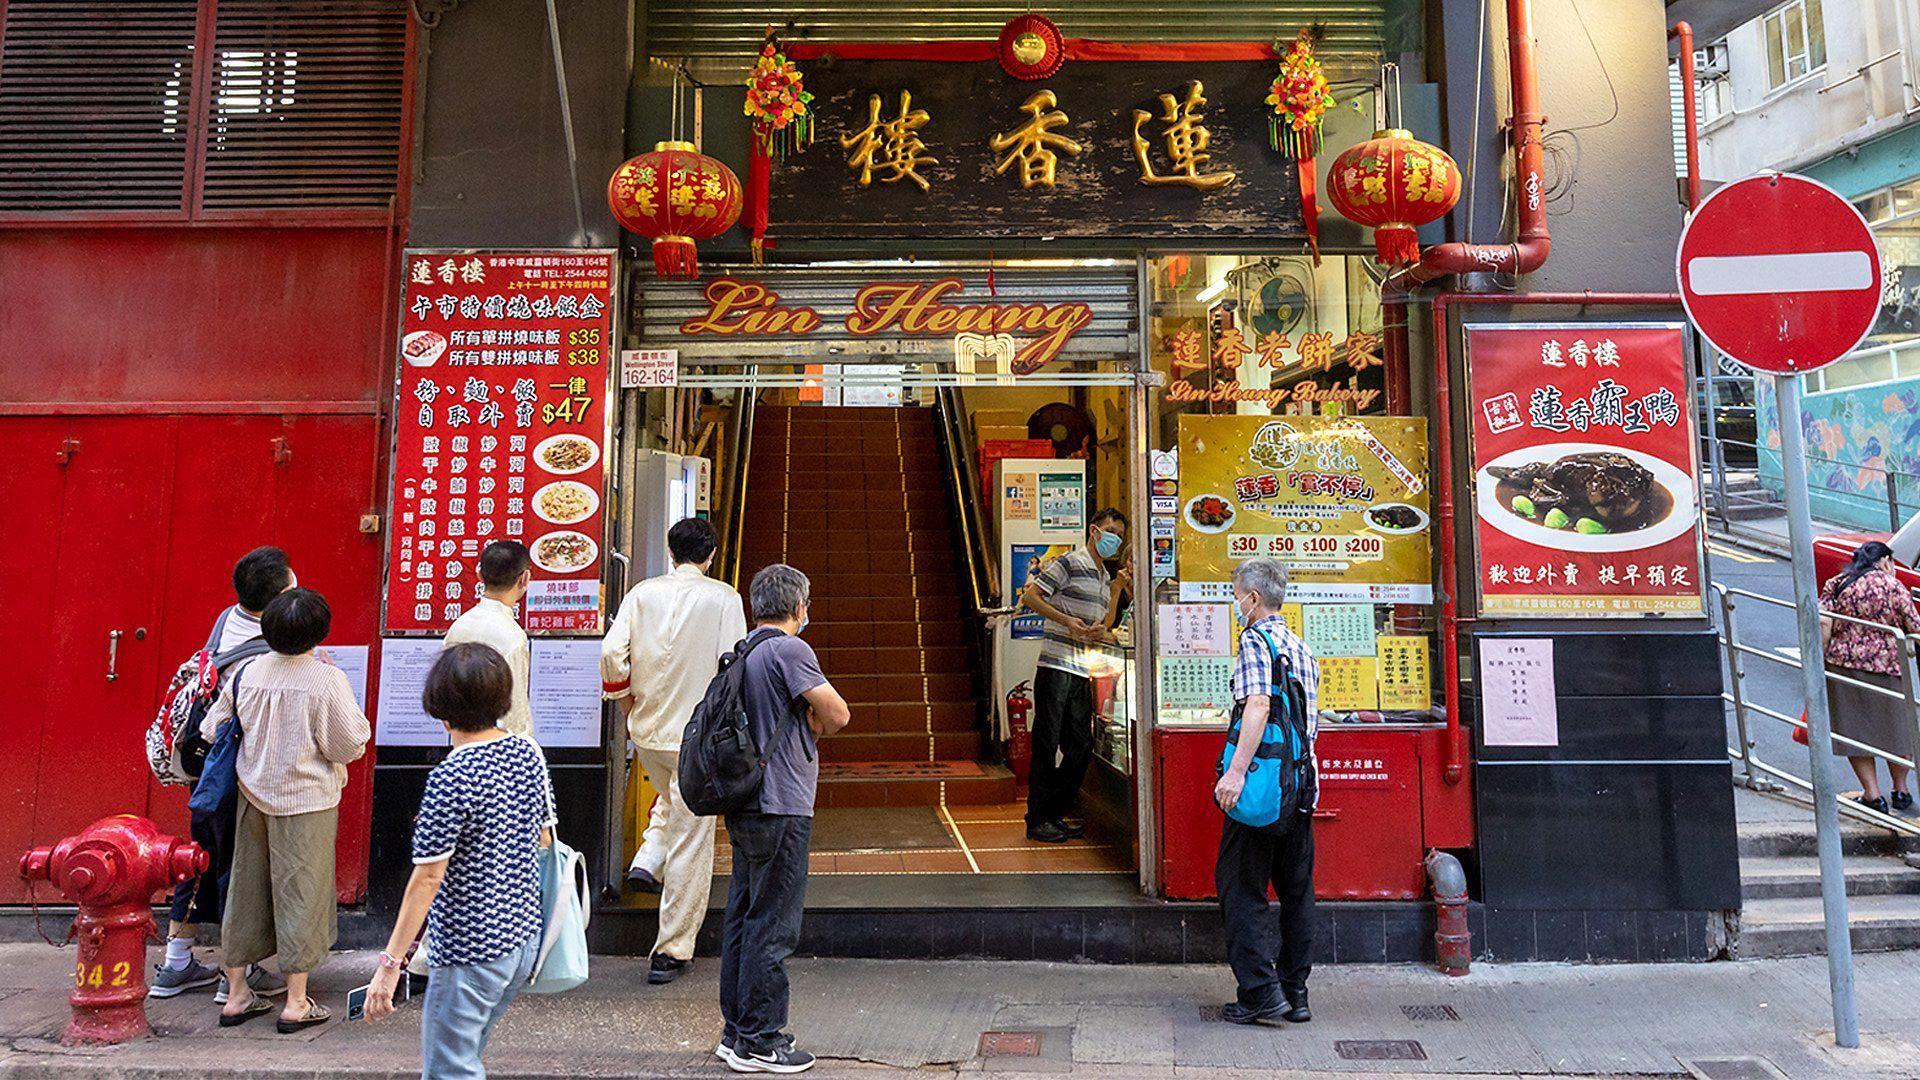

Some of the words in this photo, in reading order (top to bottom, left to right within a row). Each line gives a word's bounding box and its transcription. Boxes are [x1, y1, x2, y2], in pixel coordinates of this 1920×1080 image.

[411, 258, 486, 285] 蓮香樓
[523, 270, 541, 279] 電話
[544, 270, 563, 278] TEL:
[564, 269, 586, 278] 2544
[449, 330, 561, 346] 所有單拼燒味飯
[568, 329, 601, 345] $35
[681, 277, 821, 335] Lin
[846, 278, 1094, 375] Heung
[448, 350, 560, 366] 所有雙拼燒味飯
[567, 350, 600, 366] $38
[1171, 328, 1385, 373] 蓮香老餅家
[1540, 338, 1621, 368] 蓮香樓
[549, 377, 587, 395] 一律
[624, 369, 674, 384] 162-164
[1165, 379, 1210, 402] Lin
[1209, 380, 1290, 409] Heung
[1291, 381, 1381, 410] Bakery
[1529, 378, 1681, 434] 蓮香霸王鴨
[418, 403, 536, 428] 自取外賣
[542, 397, 593, 424] $47
[1155, 500, 1173, 509] VISA
[1231, 536, 1258, 552] $30
[1268, 536, 1295, 552] $50
[1302, 537, 1338, 553] $100
[1345, 538, 1380, 553] $200
[1487, 562, 1580, 587] 歡迎外賣
[1598, 564, 1692, 588] 提早預定
[1612, 599, 1631, 609] 電話
[1654, 600, 1676, 609] 2544
